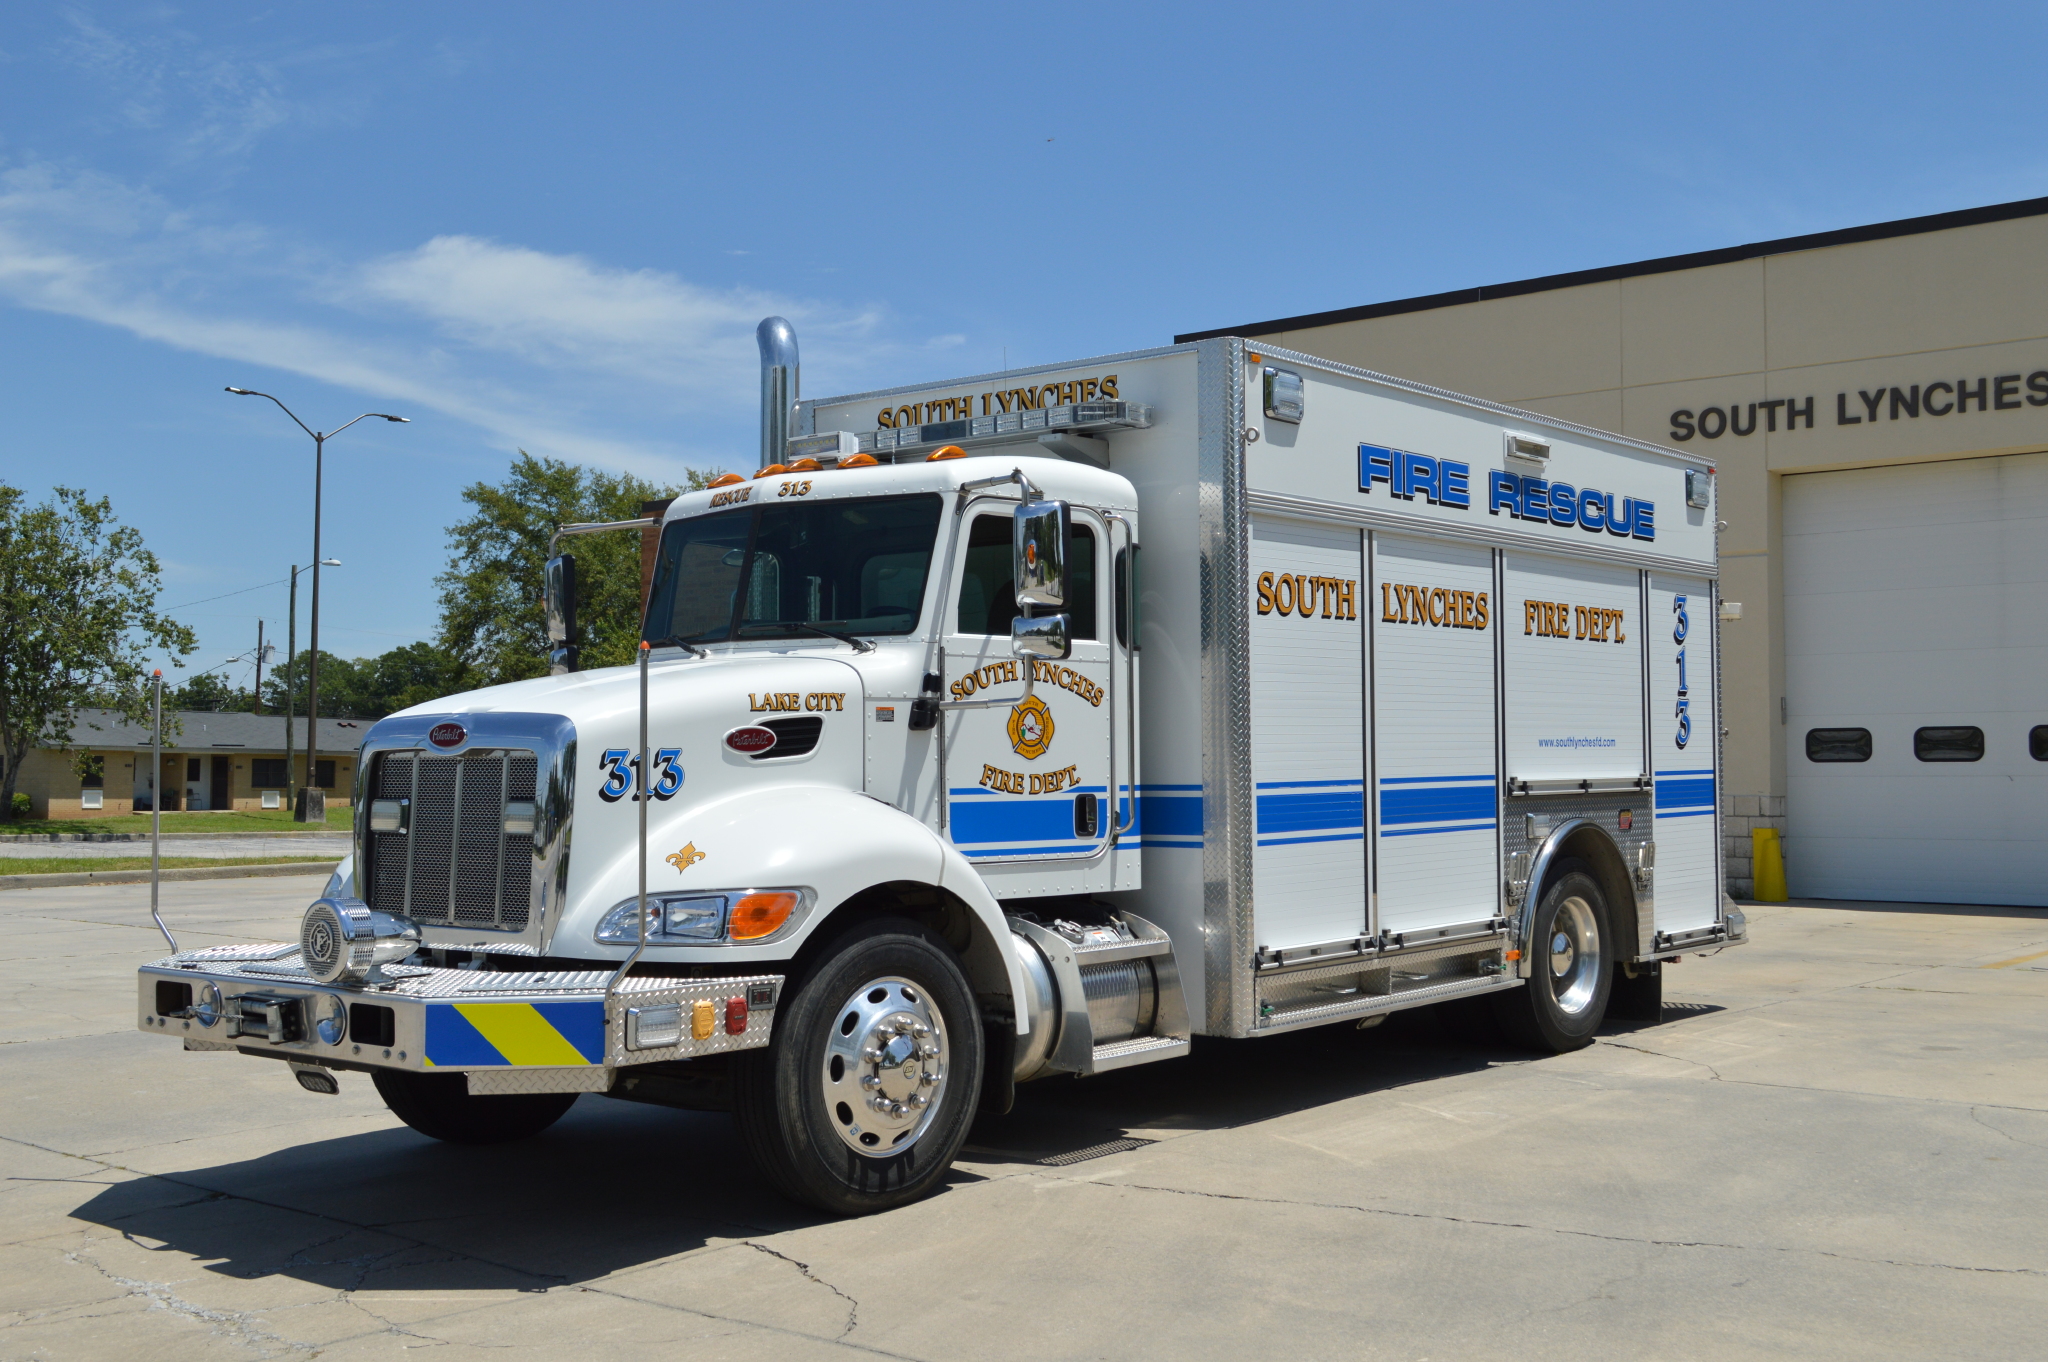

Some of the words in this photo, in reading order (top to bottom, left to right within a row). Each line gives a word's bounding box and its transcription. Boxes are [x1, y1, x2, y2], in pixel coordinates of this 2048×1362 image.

[878, 395, 974, 430] SOUTH
[1669, 396, 1815, 442] SOUTH
[1837, 371, 2048, 425] LYNCHES
[709, 486, 754, 509] RESCUE
[778, 480, 813, 497] 313
[1358, 442, 1470, 510] FIRE
[1489, 468, 1655, 542] RESCUE
[1257, 571, 1357, 621] SOUTH
[1381, 583, 1489, 630] LYNCHES
[1524, 600, 1570, 639] FIRE
[1575, 605, 1626, 644] DEPT.
[950, 660, 1018, 701] SOUTH
[1022, 660, 1104, 707] YNCHES
[1673, 594, 1691, 750] 313
[748, 692, 801, 712] LAKE
[805, 692, 846, 712] CITY
[732, 732, 771, 747] Peterbilt
[1538, 737, 1616, 749] www.southlynchesfd.com
[979, 763, 1024, 794] FIRE
[1029, 763, 1081, 795] DEPT.
